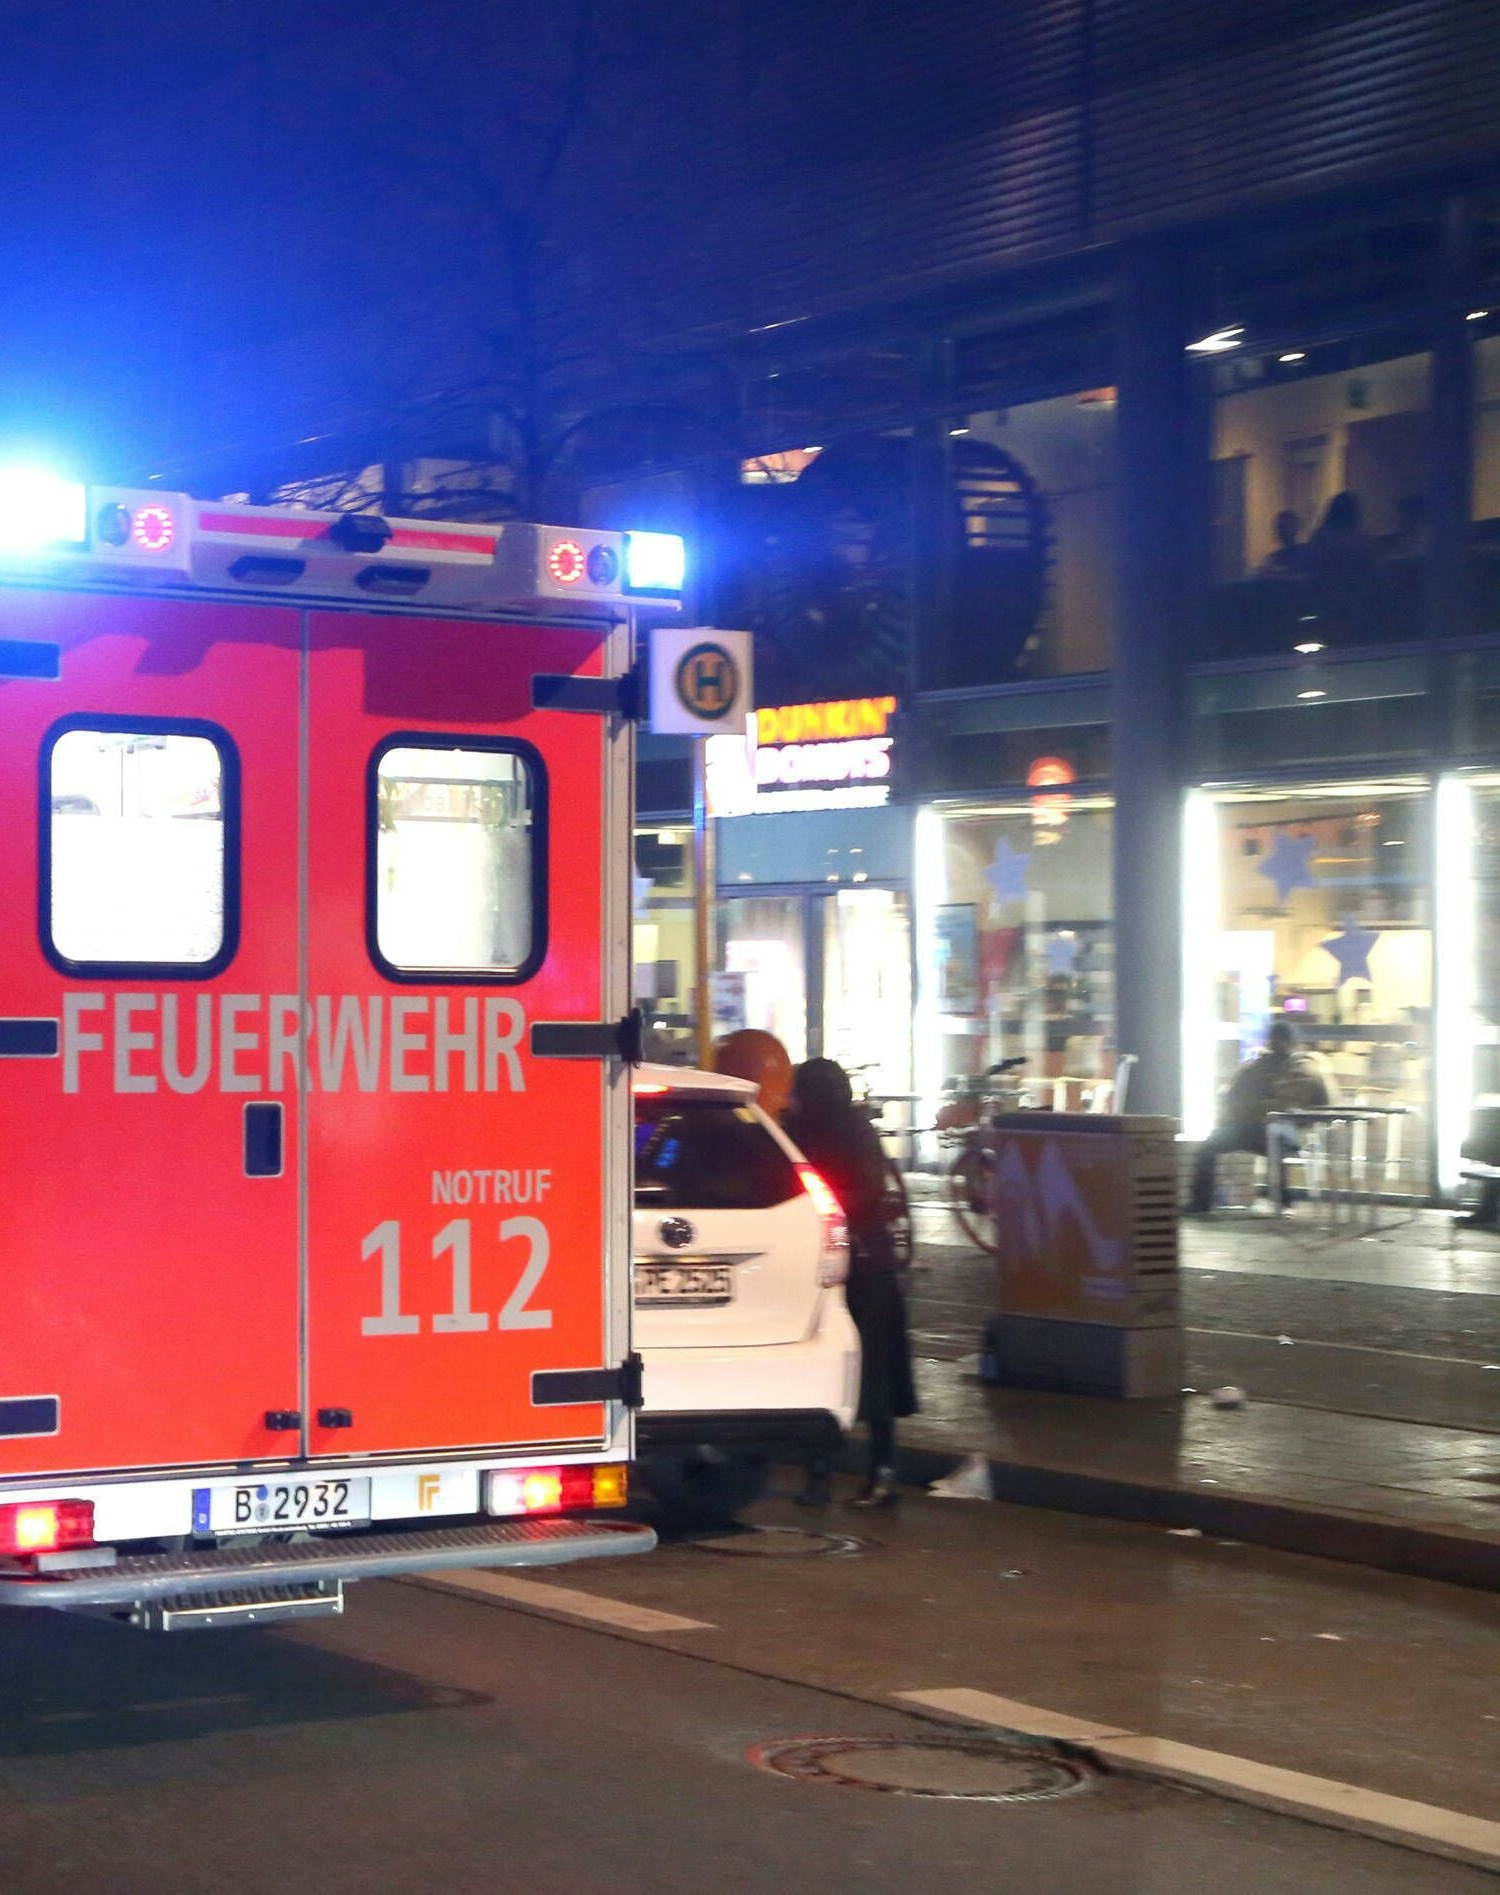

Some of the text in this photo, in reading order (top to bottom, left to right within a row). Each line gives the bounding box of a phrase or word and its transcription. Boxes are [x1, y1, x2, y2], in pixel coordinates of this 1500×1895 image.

[694, 658, 727, 705] H
[62, 993, 526, 1094] FEUERWEHR
[431, 1168, 551, 1205] NOTRUF
[360, 1215, 552, 1337] 112
[235, 1490, 251, 1522] B
[274, 1483, 348, 1520] 2932
